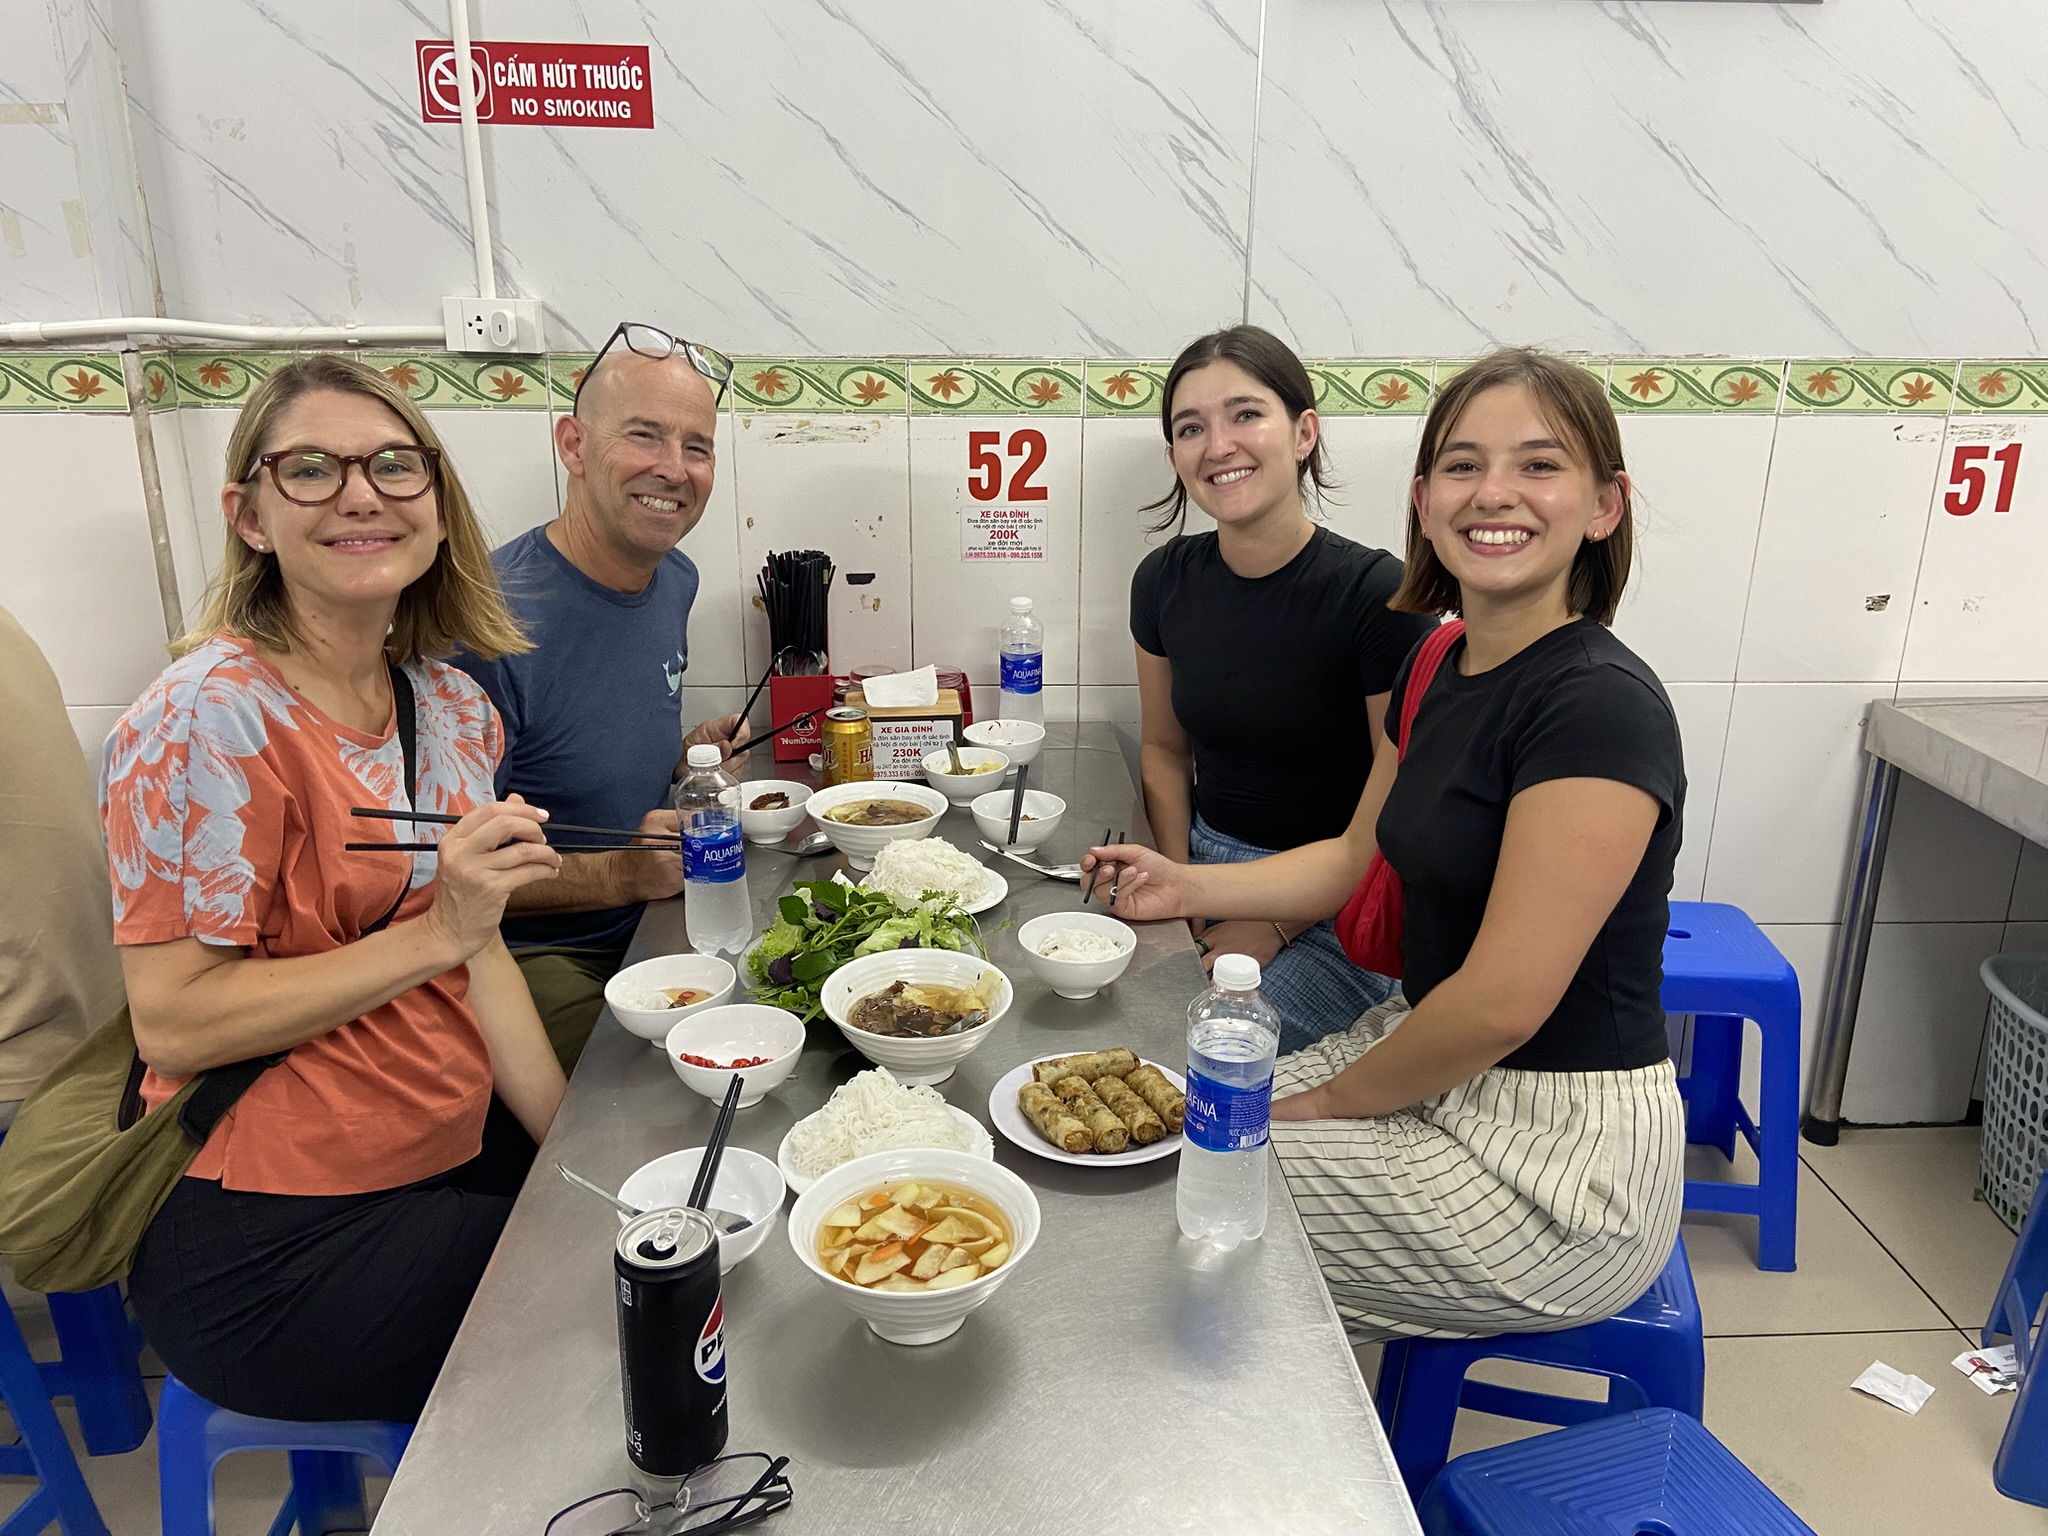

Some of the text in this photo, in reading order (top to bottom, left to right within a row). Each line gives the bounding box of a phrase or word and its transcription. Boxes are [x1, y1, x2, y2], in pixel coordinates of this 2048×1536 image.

[493, 53, 644, 91] CẤM HÚT THUỐC
[511, 98, 632, 119] NO SMOKING
[968, 428, 1048, 502] 52
[1944, 443, 2022, 516] 51
[980, 509, 1029, 519] XE GIA ĐÌNH
[990, 530, 1019, 540] 200K
[880, 726, 892, 734] XE
[892, 748, 922, 758] 230K
[703, 840, 744, 863] AQUAFINA
